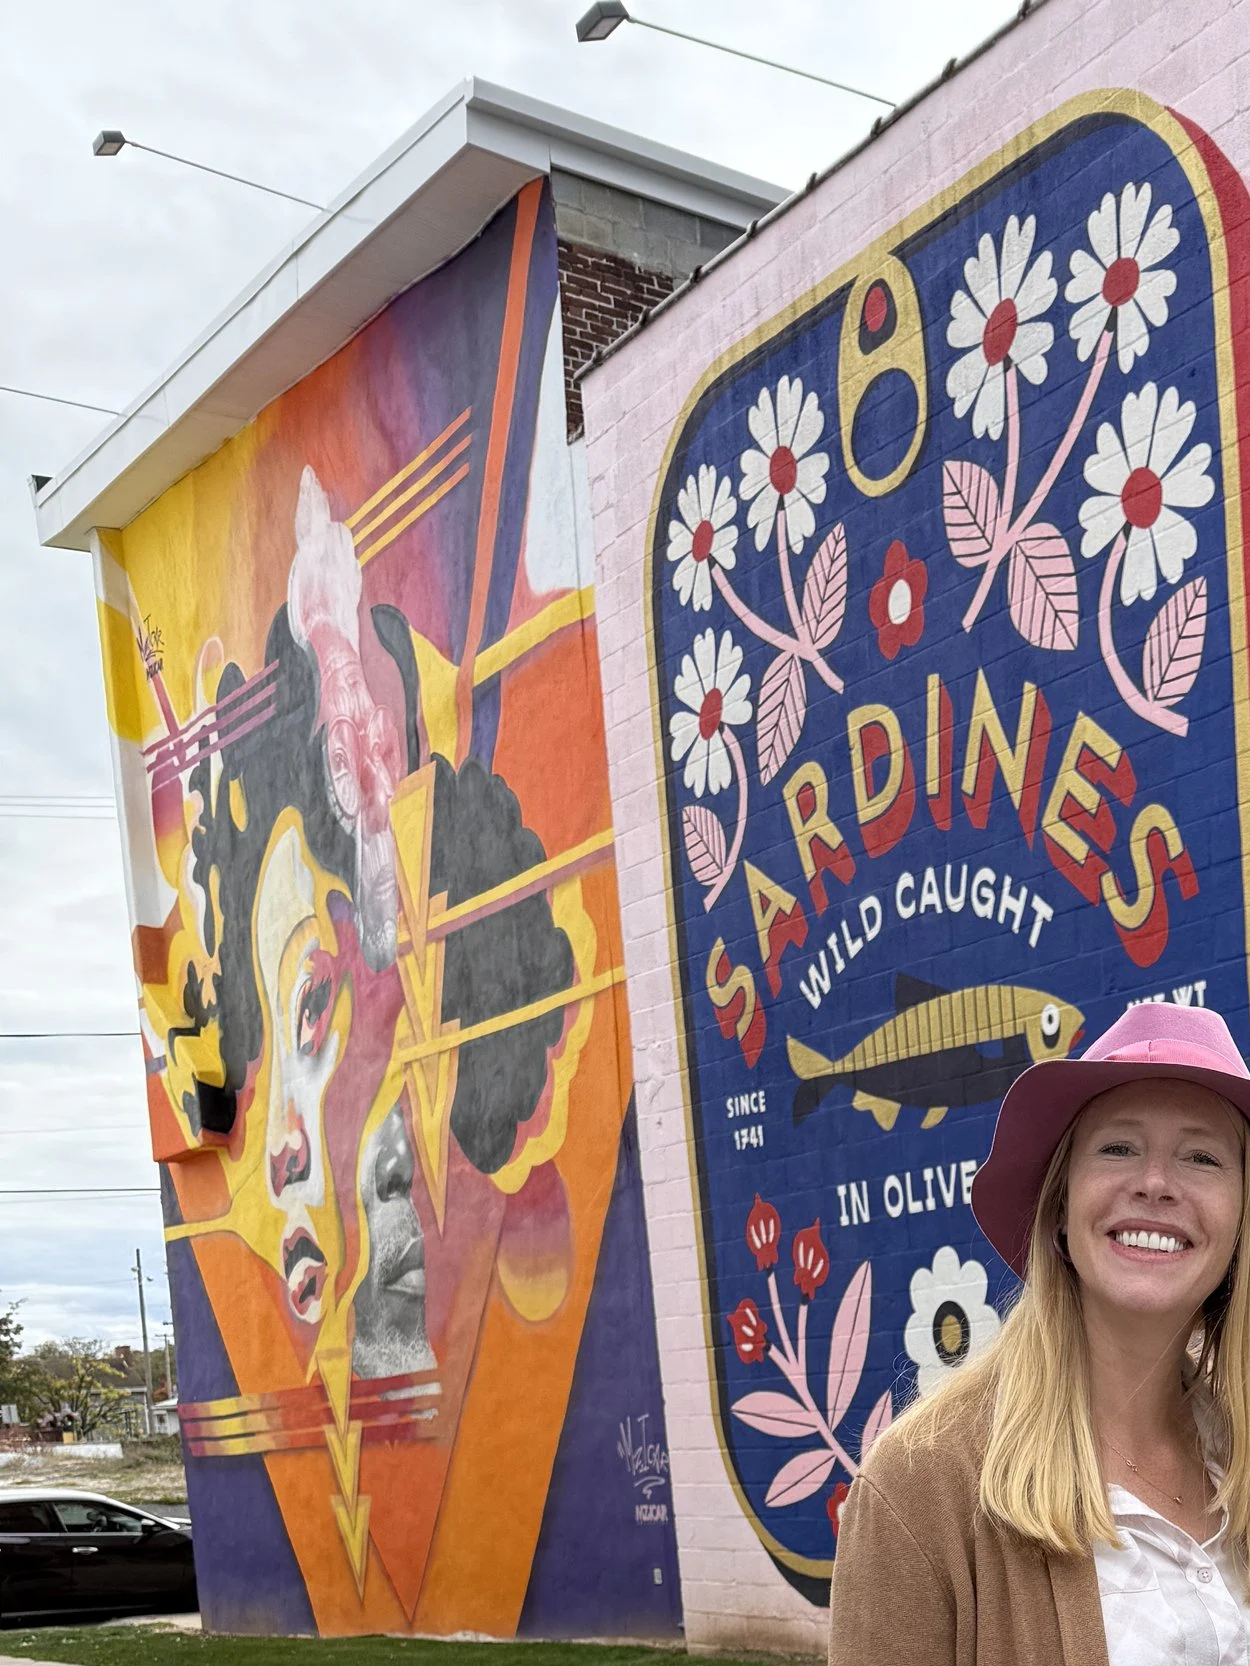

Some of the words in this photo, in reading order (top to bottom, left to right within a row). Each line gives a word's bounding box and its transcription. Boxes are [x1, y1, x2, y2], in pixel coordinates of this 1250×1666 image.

[705, 667, 1198, 1068] SARDINES
[799, 895, 883, 1010] WILD
[895, 863, 1055, 949] CAUGHT
[725, 1090, 767, 1119] SINCE
[734, 1124, 764, 1151] 1741
[836, 1180, 871, 1227] IN
[883, 1159, 978, 1218] OLIVE
